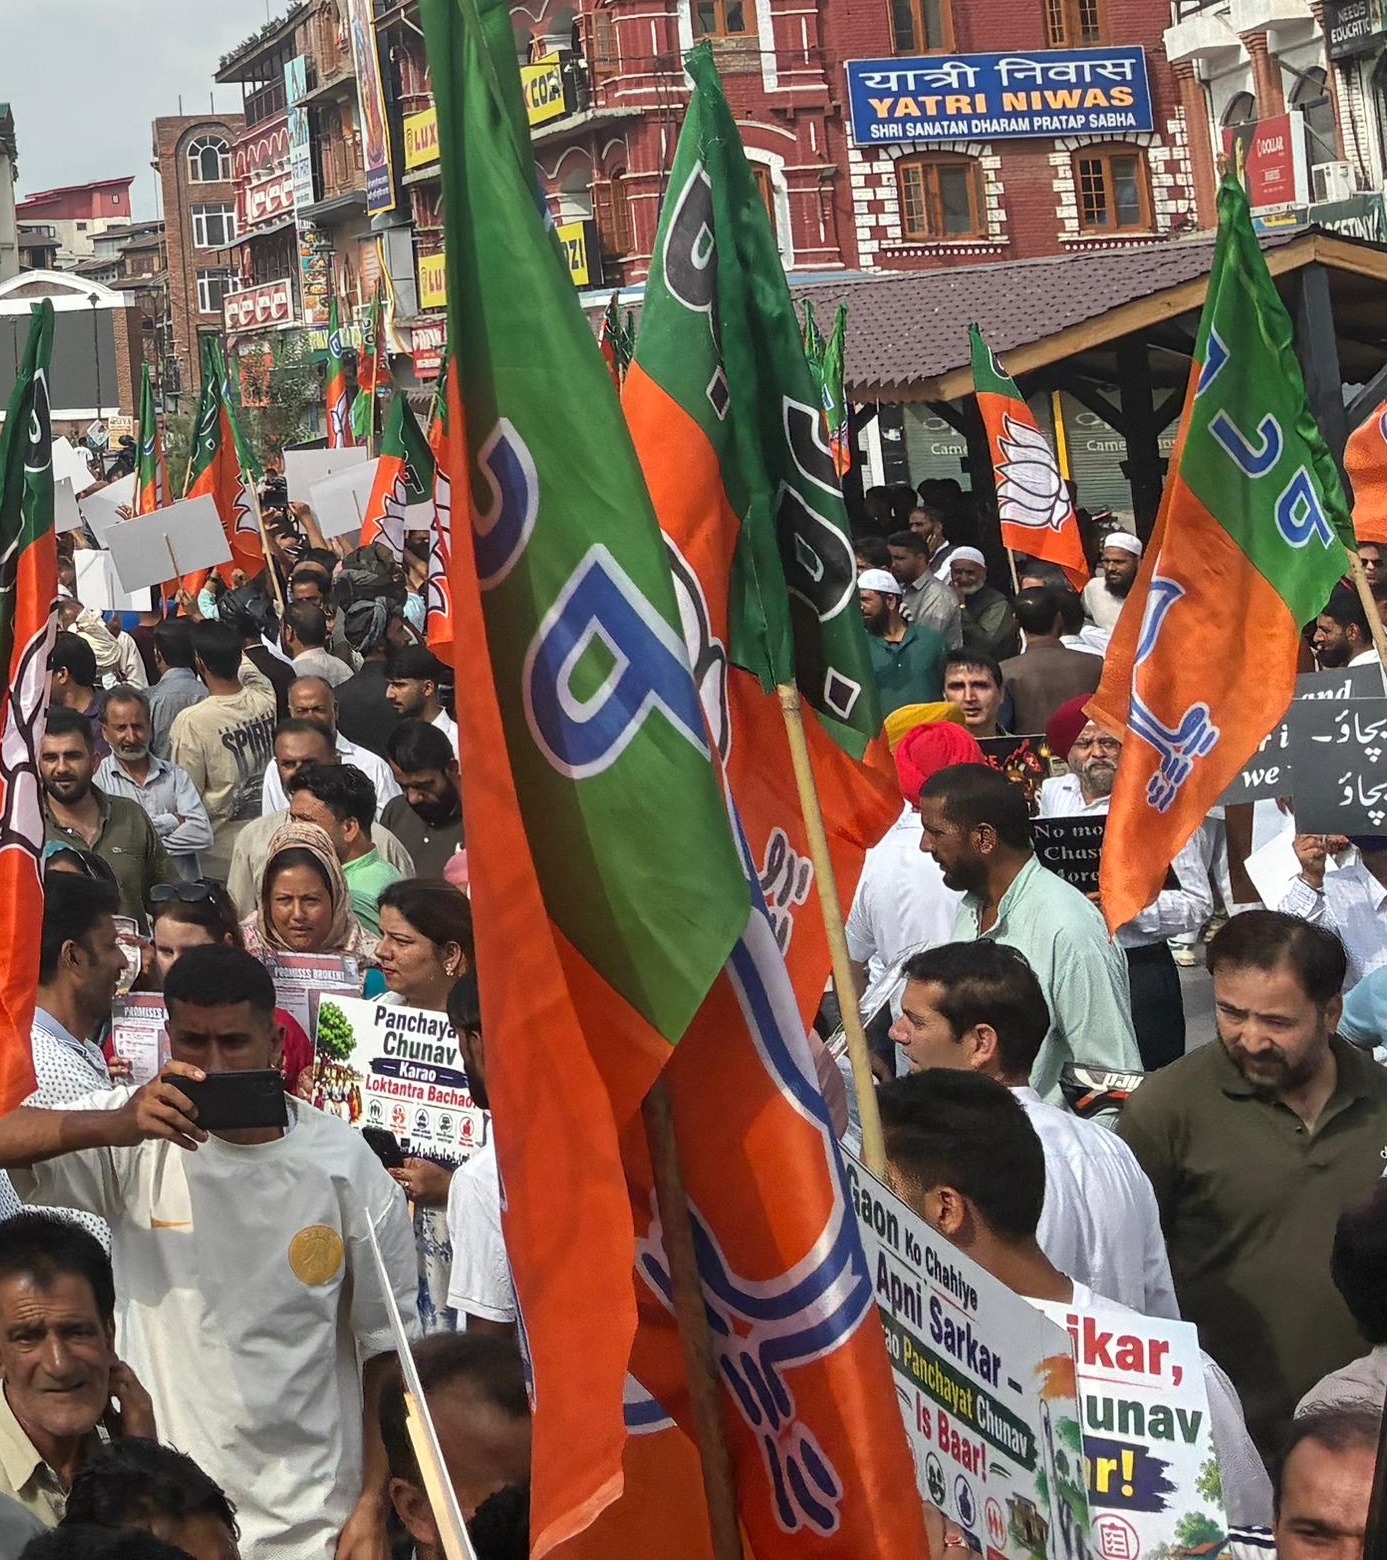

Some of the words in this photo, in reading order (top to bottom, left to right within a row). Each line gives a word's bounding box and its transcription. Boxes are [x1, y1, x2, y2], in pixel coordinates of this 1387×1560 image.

[1338, 1, 1365, 24] NEEDS
[859, 62, 980, 93] यात्री
[994, 57, 1137, 88] निवास
[867, 93, 986, 118] YATRI
[1002, 86, 1135, 113] NIWAS
[870, 122, 904, 139] SHRI
[906, 120, 969, 137] SANATAN
[971, 117, 1032, 133] DHARAM
[1034, 115, 1087, 130] PRATAP
[1089, 113, 1136, 128] SABHA
[428, 268, 446, 288] LU
[1243, 766, 1280, 788] we
[1034, 824, 1065, 839] No
[1073, 824, 1103, 837] mo
[124, 1006, 162, 1019] PROMISES
[374, 1005, 457, 1041] Panchaya
[383, 1031, 457, 1065] Chunav
[365, 1074, 424, 1100] Loktantra
[399, 1062, 436, 1082] Karao
[847, 1163, 899, 1251] Gaon
[905, 1228, 922, 1266] Ko
[926, 1245, 979, 1312] Chahiye
[877, 1251, 922, 1325] Apni
[929, 1296, 1001, 1389] Sarkar
[903, 1333, 973, 1417] Panchayat
[976, 1396, 1027, 1458] Chunav
[1086, 1394, 1202, 1443] unav
[916, 1392, 931, 1439] Is
[937, 1407, 987, 1483] Baar!
